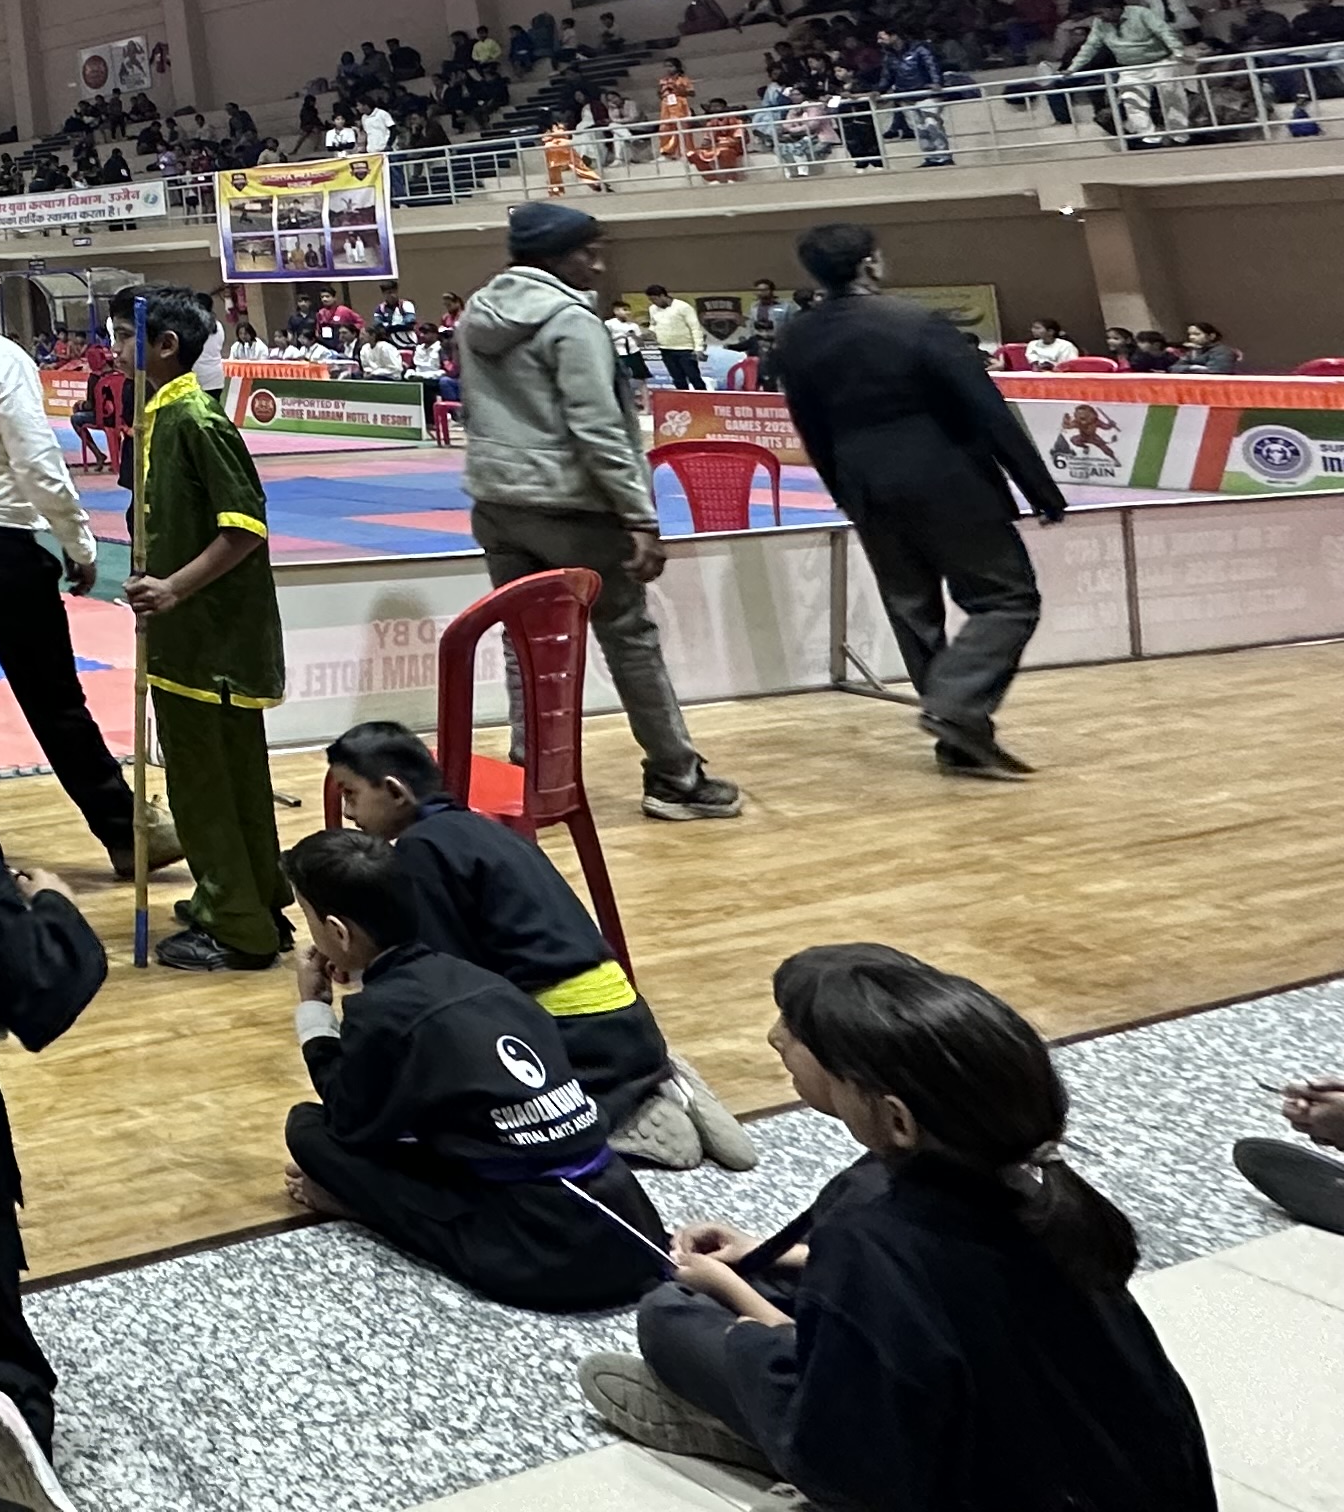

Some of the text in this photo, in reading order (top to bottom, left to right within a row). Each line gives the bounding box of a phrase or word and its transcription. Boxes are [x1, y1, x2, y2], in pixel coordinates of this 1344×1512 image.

[281, 398, 346, 410] SUPPORTED BY
[713, 405, 732, 417] THE
[281, 408, 304, 420] SHREE
[346, 411, 371, 425] HOTEL
[380, 414, 412, 427] RESORT
[725, 420, 762, 431] GAMES
[548, 1078, 586, 1115] KUN
